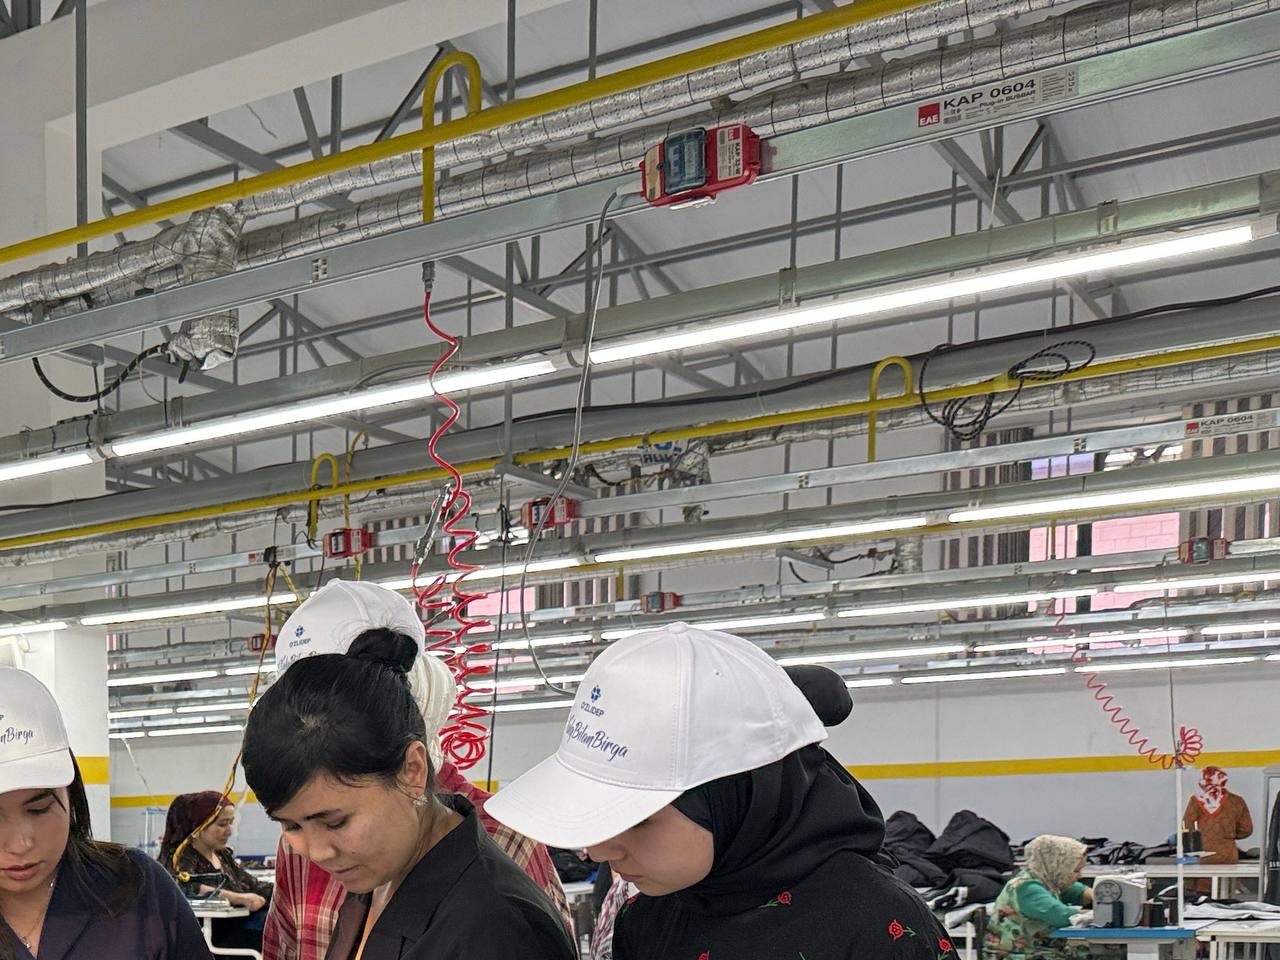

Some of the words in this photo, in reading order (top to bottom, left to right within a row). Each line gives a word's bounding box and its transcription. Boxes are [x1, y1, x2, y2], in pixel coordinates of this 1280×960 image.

[943, 92, 983, 110] KAP
[990, 79, 1036, 98] 0604
[919, 114, 939, 126] EAE
[1200, 418, 1224, 427] KAP
